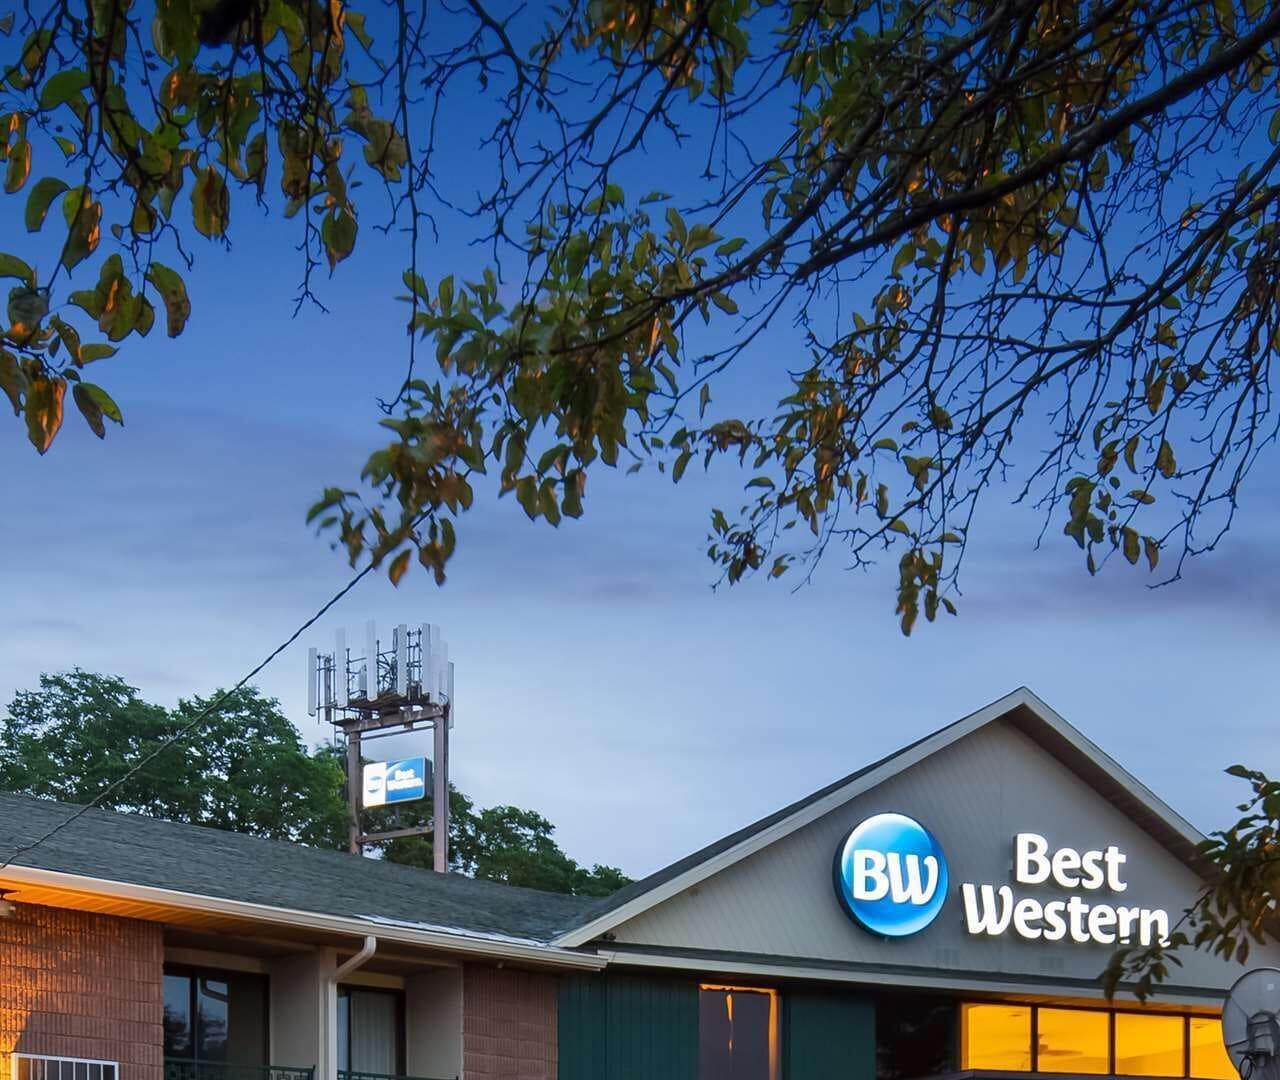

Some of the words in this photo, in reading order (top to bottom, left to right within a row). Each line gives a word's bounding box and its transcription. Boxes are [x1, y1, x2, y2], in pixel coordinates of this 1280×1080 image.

[853, 849, 938, 906] BW
[1014, 833, 1128, 892] Best
[961, 883, 1171, 948] Western
